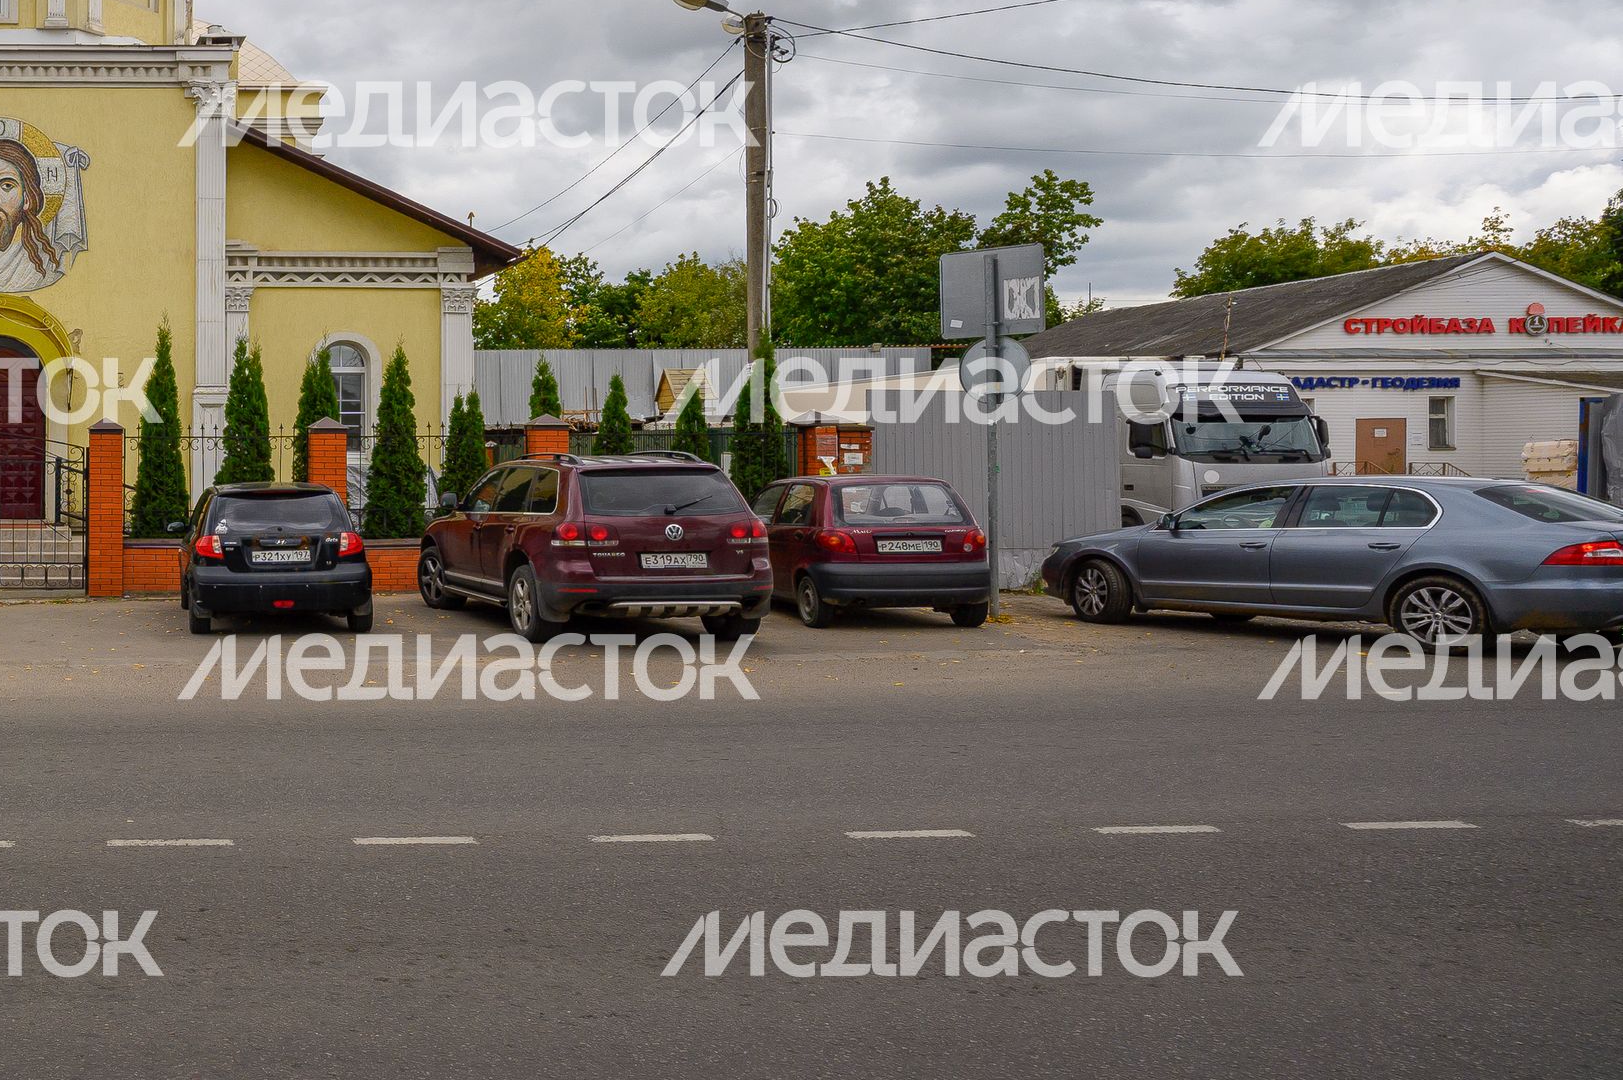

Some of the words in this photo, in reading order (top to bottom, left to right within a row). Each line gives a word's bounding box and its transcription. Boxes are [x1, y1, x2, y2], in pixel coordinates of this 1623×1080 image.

[1344, 315, 1495, 334] СТРОЙБАЗА
[1509, 314, 1623, 336] КОПЕЙК
[1176, 385, 1289, 393] PERFORMANCE
[1291, 376, 1360, 390] АДАСТР
[1371, 376, 1460, 391] ГЕОДЕЗИЯ
[1209, 393, 1264, 401] EDITION
